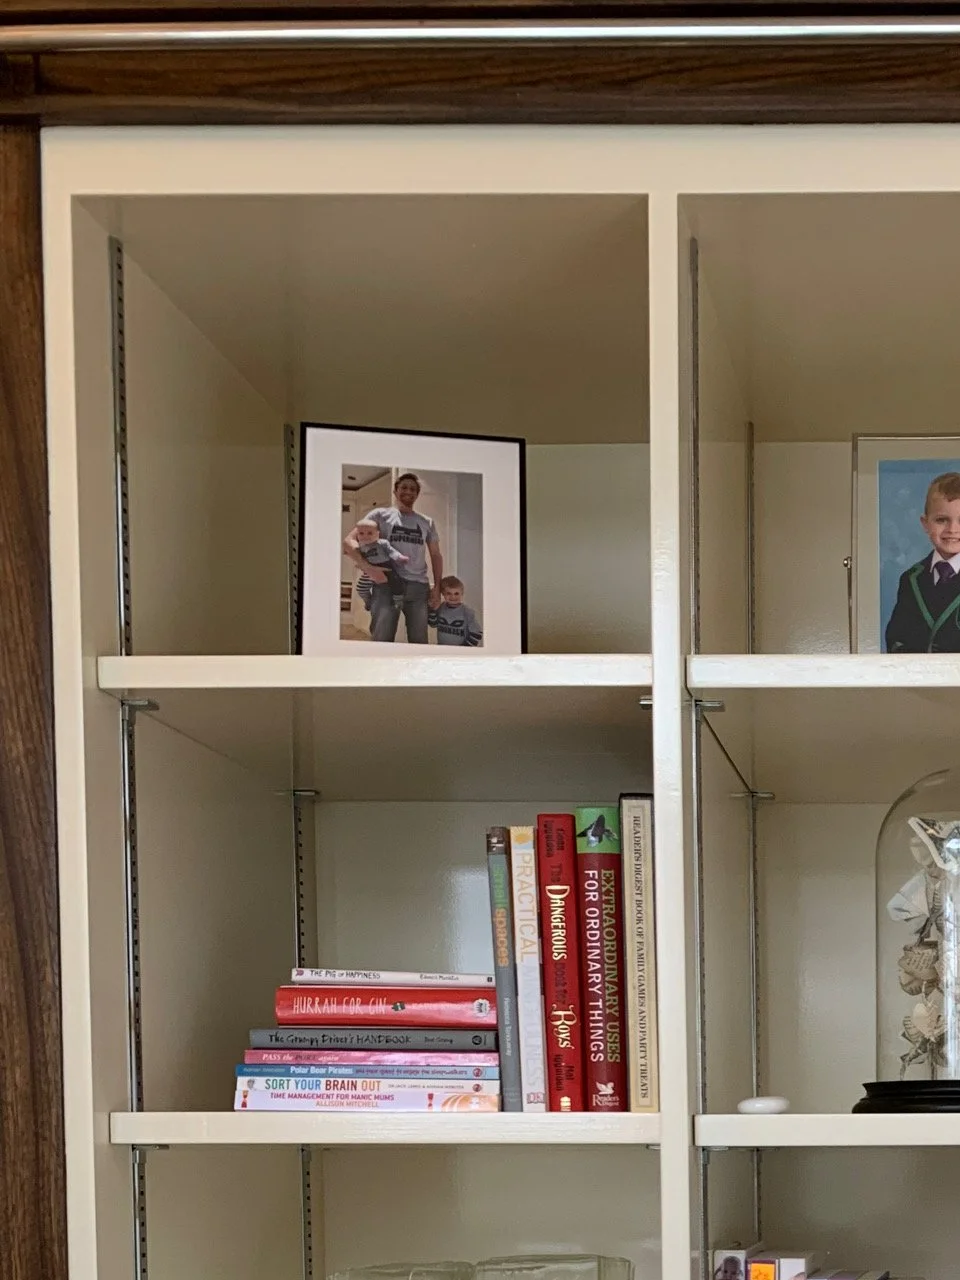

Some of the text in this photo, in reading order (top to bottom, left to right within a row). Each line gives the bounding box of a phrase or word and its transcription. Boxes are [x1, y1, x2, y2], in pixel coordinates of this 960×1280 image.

[633, 815, 643, 862] READER'S
[634, 863, 643, 898] DIGEST
[516, 852, 538, 962] PRACTICAL
[635, 899, 643, 925] BOOK
[636, 926, 644, 939] OF
[584, 869, 605, 1063] FOR ORDINARY THINGS
[601, 868, 621, 1063] EXTRAORDINARY USES
[637, 941, 646, 974] FAMILY
[325, 970, 337, 978] PIG
[346, 971, 381, 979] HAPPINESS
[293, 996, 387, 1015] HURRAH FOR GIN
[638, 975, 646, 1008] GAMES
[269, 1031, 411, 1047] The Grumpy Driver's HANDBOOK
[639, 1031, 648, 1062] PARTY
[262, 1053, 281, 1061] PASS
[290, 1066, 309, 1074] Polar
[310, 1066, 327, 1074] Bear
[328, 1066, 354, 1075] Pirates
[265, 1078, 291, 1091] SORT
[295, 1079, 322, 1091] YOUR
[325, 1079, 358, 1092] BRAIN
[361, 1080, 381, 1092] OUT
[640, 1063, 648, 1099] TREATS
[270, 1092, 285, 1100] TIME
[288, 1092, 334, 1100] MANAGEMENT
